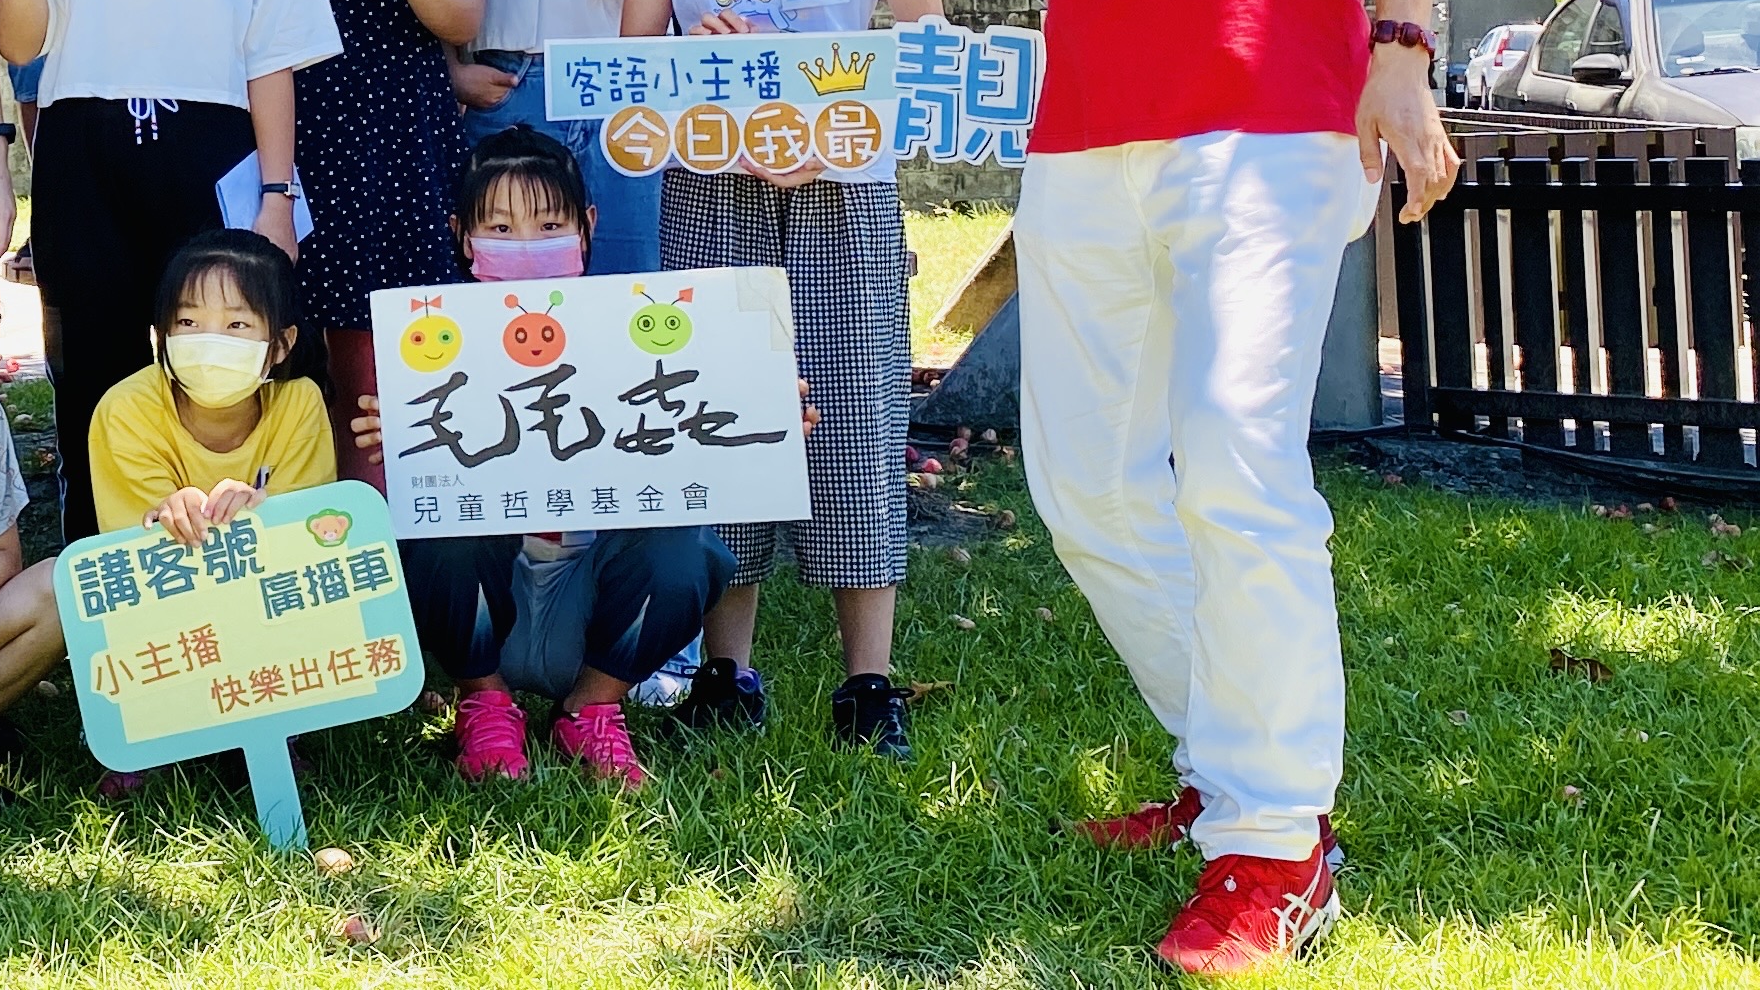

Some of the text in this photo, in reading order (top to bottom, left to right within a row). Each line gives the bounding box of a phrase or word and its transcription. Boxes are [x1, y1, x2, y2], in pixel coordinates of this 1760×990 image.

[566, 51, 781, 106] 客語小主播
[611, 107, 876, 167] 今日我最
[411, 474, 465, 489] 財團法人
[414, 482, 710, 525] 兒童哲學基金會
[74, 518, 265, 618] 講客號
[259, 547, 394, 620] 廣播車
[95, 623, 222, 697] 小主播
[211, 639, 403, 715] 快樂出任務
